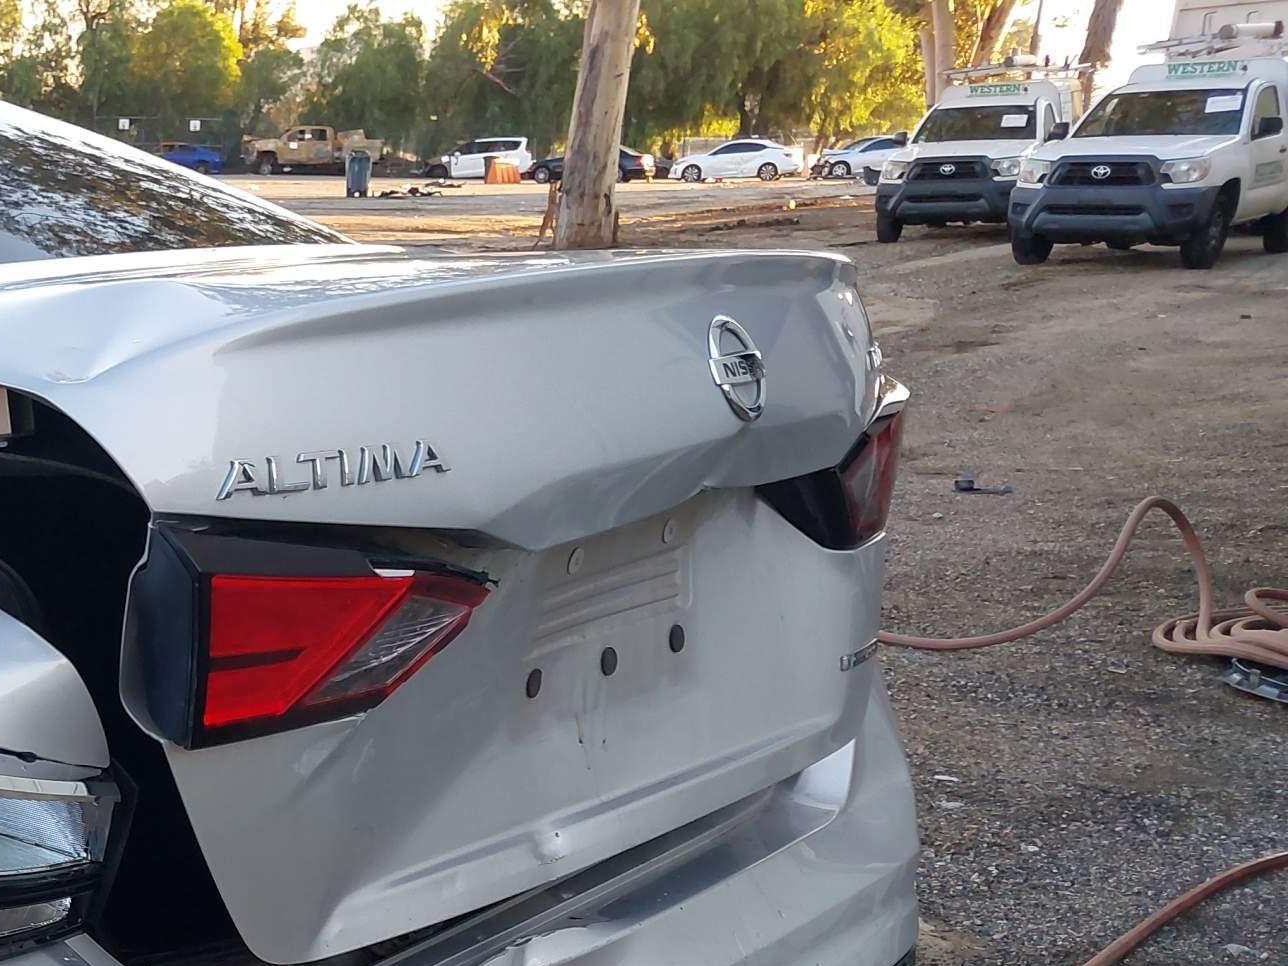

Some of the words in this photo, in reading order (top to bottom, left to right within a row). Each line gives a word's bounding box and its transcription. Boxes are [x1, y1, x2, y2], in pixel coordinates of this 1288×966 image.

[1167, 61, 1238, 75] WESTERN
[969, 84, 1020, 95] WESTERN
[215, 440, 452, 501] ALTIMA
